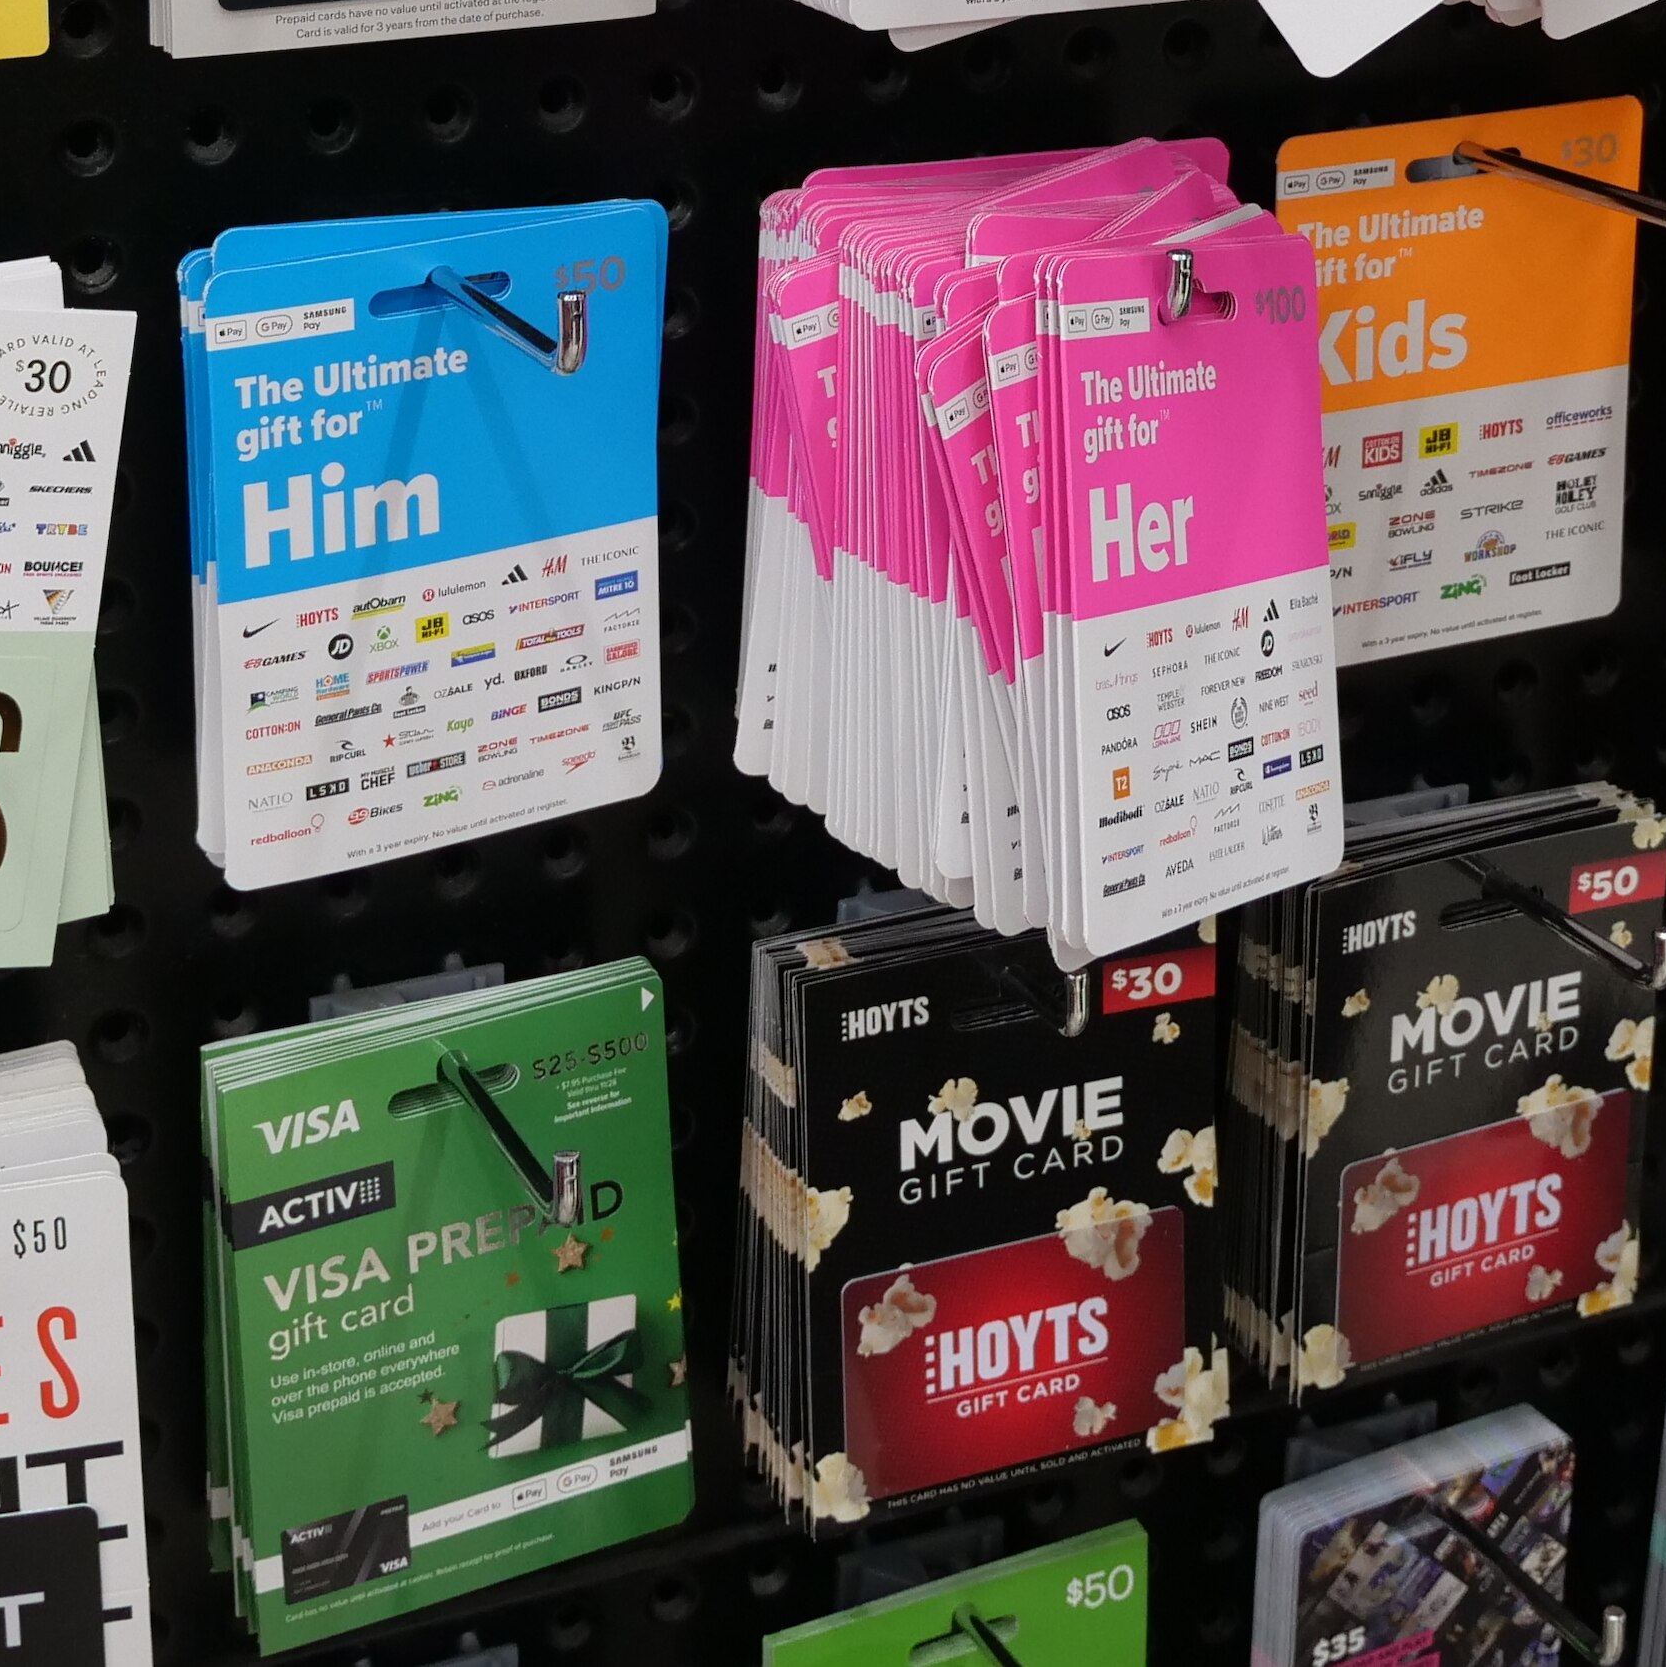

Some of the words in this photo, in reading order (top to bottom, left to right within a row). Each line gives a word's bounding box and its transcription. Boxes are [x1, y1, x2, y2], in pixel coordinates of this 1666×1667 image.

[1255, 284, 1306, 325] $100
[15, 358, 71, 394] $30
[235, 375, 304, 409] The
[314, 345, 469, 399] Ultimate
[1081, 369, 1124, 406] The
[1128, 360, 1216, 398] Ultimate
[1546, 404, 1612, 428] officeworks
[29, 484, 92, 495] SKECHERS
[1468, 462, 1533, 479] TIMEZONE
[243, 461, 440, 568] Him
[1461, 500, 1523, 519] STRIKE
[1088, 483, 1194, 583] Her
[245, 719, 301, 739] COTTON:ON
[497, 769, 545, 789] adrenaline
[251, 825, 312, 846] redballoon
[1577, 865, 1640, 901] $50
[1111, 963, 1183, 1000] $30
[848, 996, 929, 1039] HOYTS
[1388, 972, 1583, 1063] MOVIE
[253, 1100, 361, 1154] VISA
[899, 1076, 1125, 1172] MOVIE
[899, 1161, 990, 1206] GIFT
[1013, 1135, 1125, 1182] CARD
[259, 1183, 357, 1234] ACTIV
[14, 1217, 67, 1259] $50
[268, 1314, 327, 1362] gift
[340, 1283, 416, 1333] card
[938, 1296, 1108, 1390] HOYTS
[1066, 1564, 1135, 1606] $50
[1311, 1628, 1367, 1666] $35
